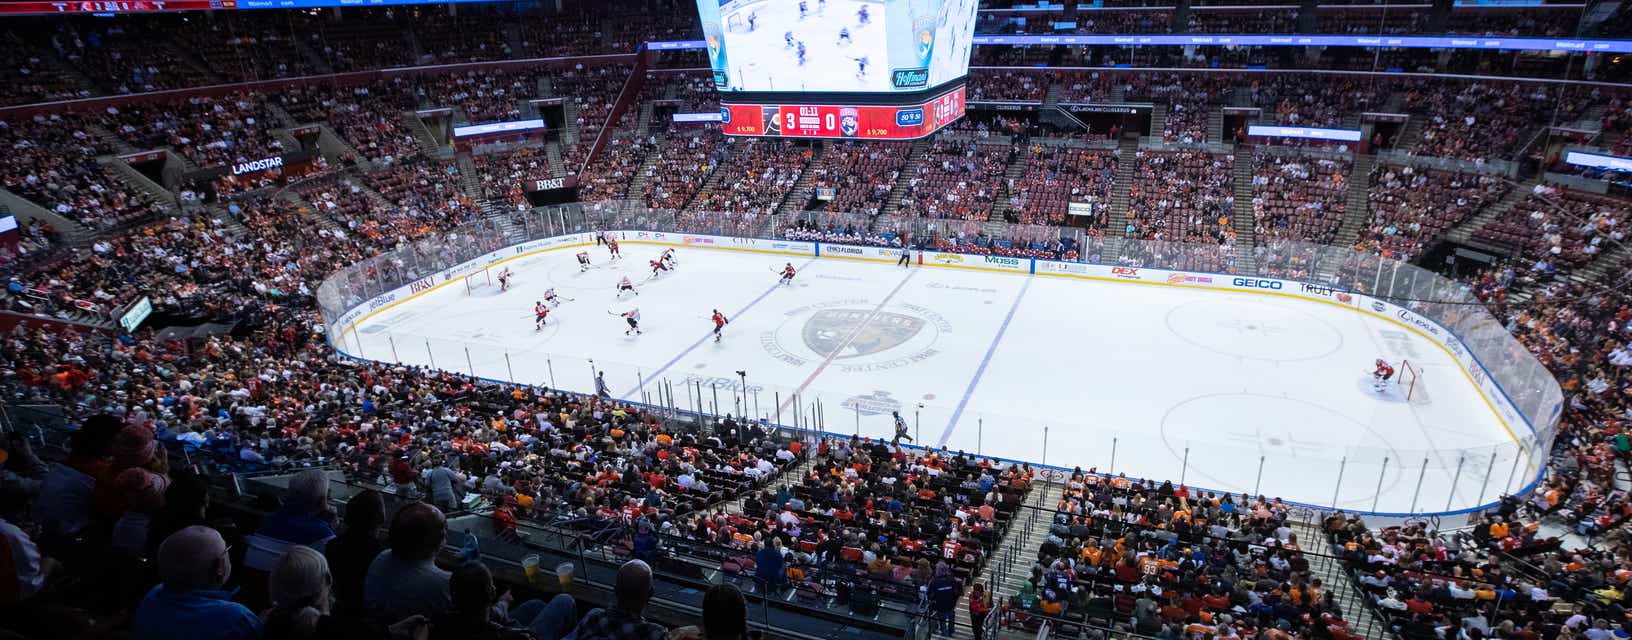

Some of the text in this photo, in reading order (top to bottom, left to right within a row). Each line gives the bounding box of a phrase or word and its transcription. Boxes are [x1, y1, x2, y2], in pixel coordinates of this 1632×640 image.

[800, 106, 819, 117] 01:11
[786, 112, 796, 130] 3
[826, 113, 836, 130] 0
[232, 156, 283, 175] LANDSTAR
[536, 177, 566, 191] BB&T
[841, 246, 863, 255] FLORIDA
[1112, 267, 1138, 276] DEX
[410, 277, 435, 294] BB&T
[1233, 277, 1283, 290] GEICO
[1301, 283, 1334, 297] TRULY
